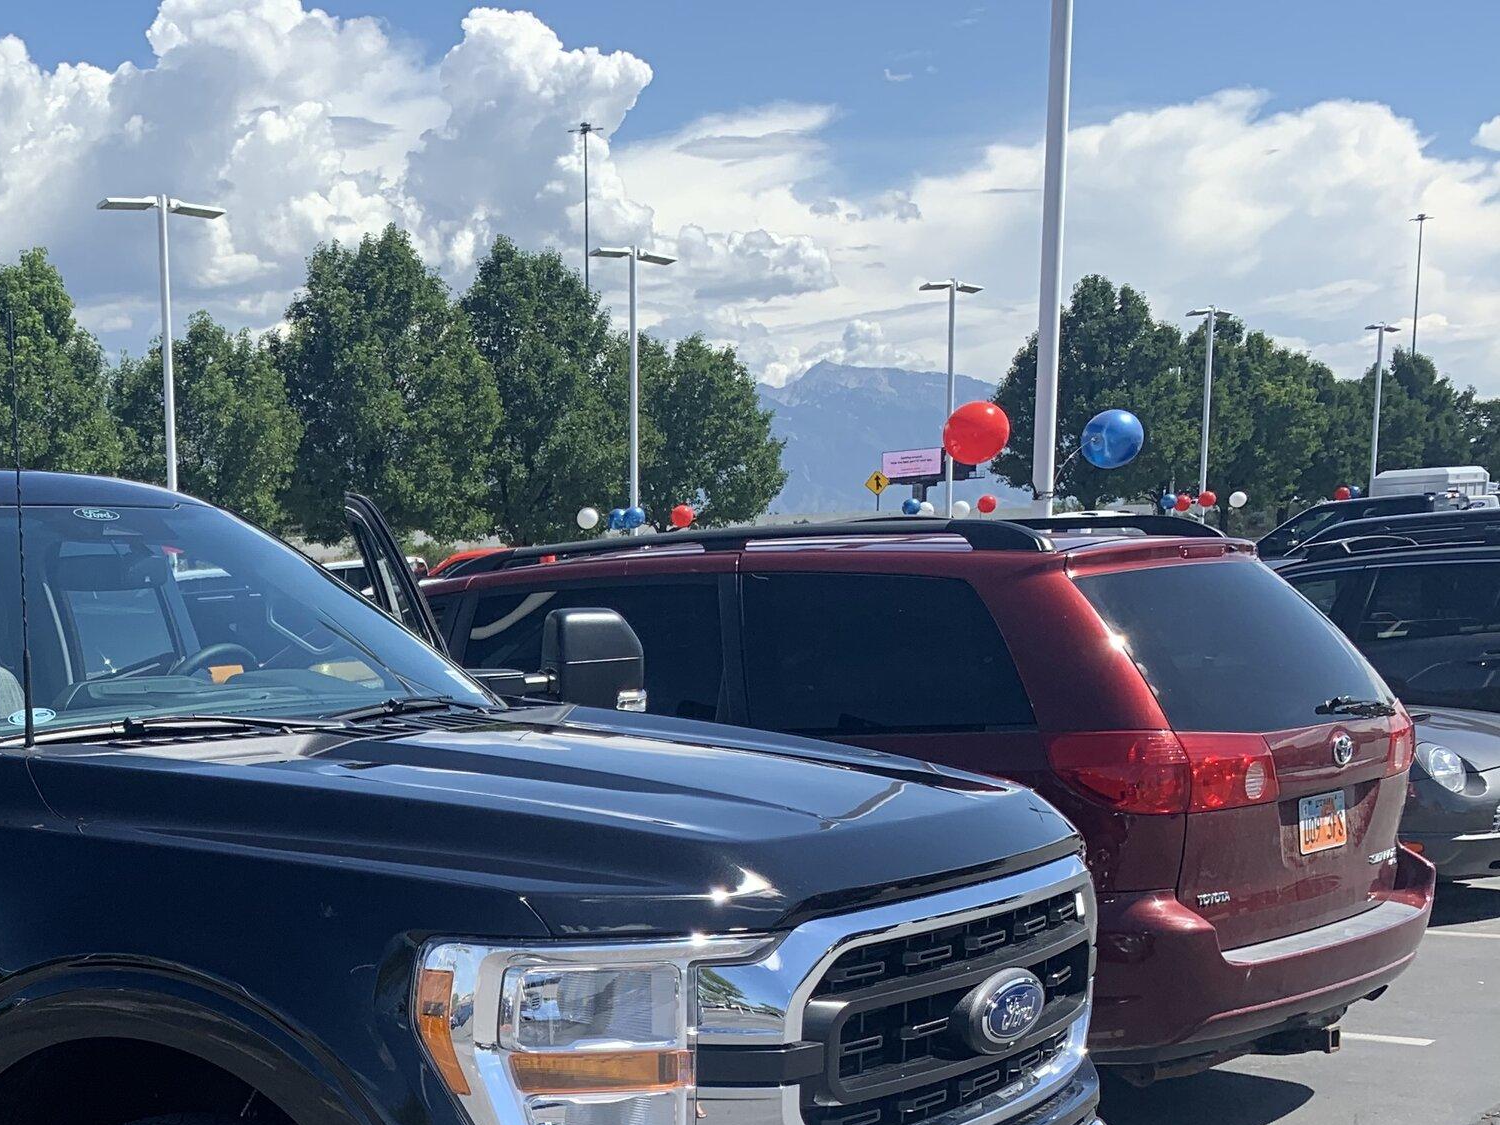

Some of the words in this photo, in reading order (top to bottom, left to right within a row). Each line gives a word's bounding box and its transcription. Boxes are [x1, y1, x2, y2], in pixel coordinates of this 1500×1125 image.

[80, 508, 115, 520] Ford
[1196, 891, 1230, 906] TOYOTA
[1001, 992, 1036, 1031] Ford
